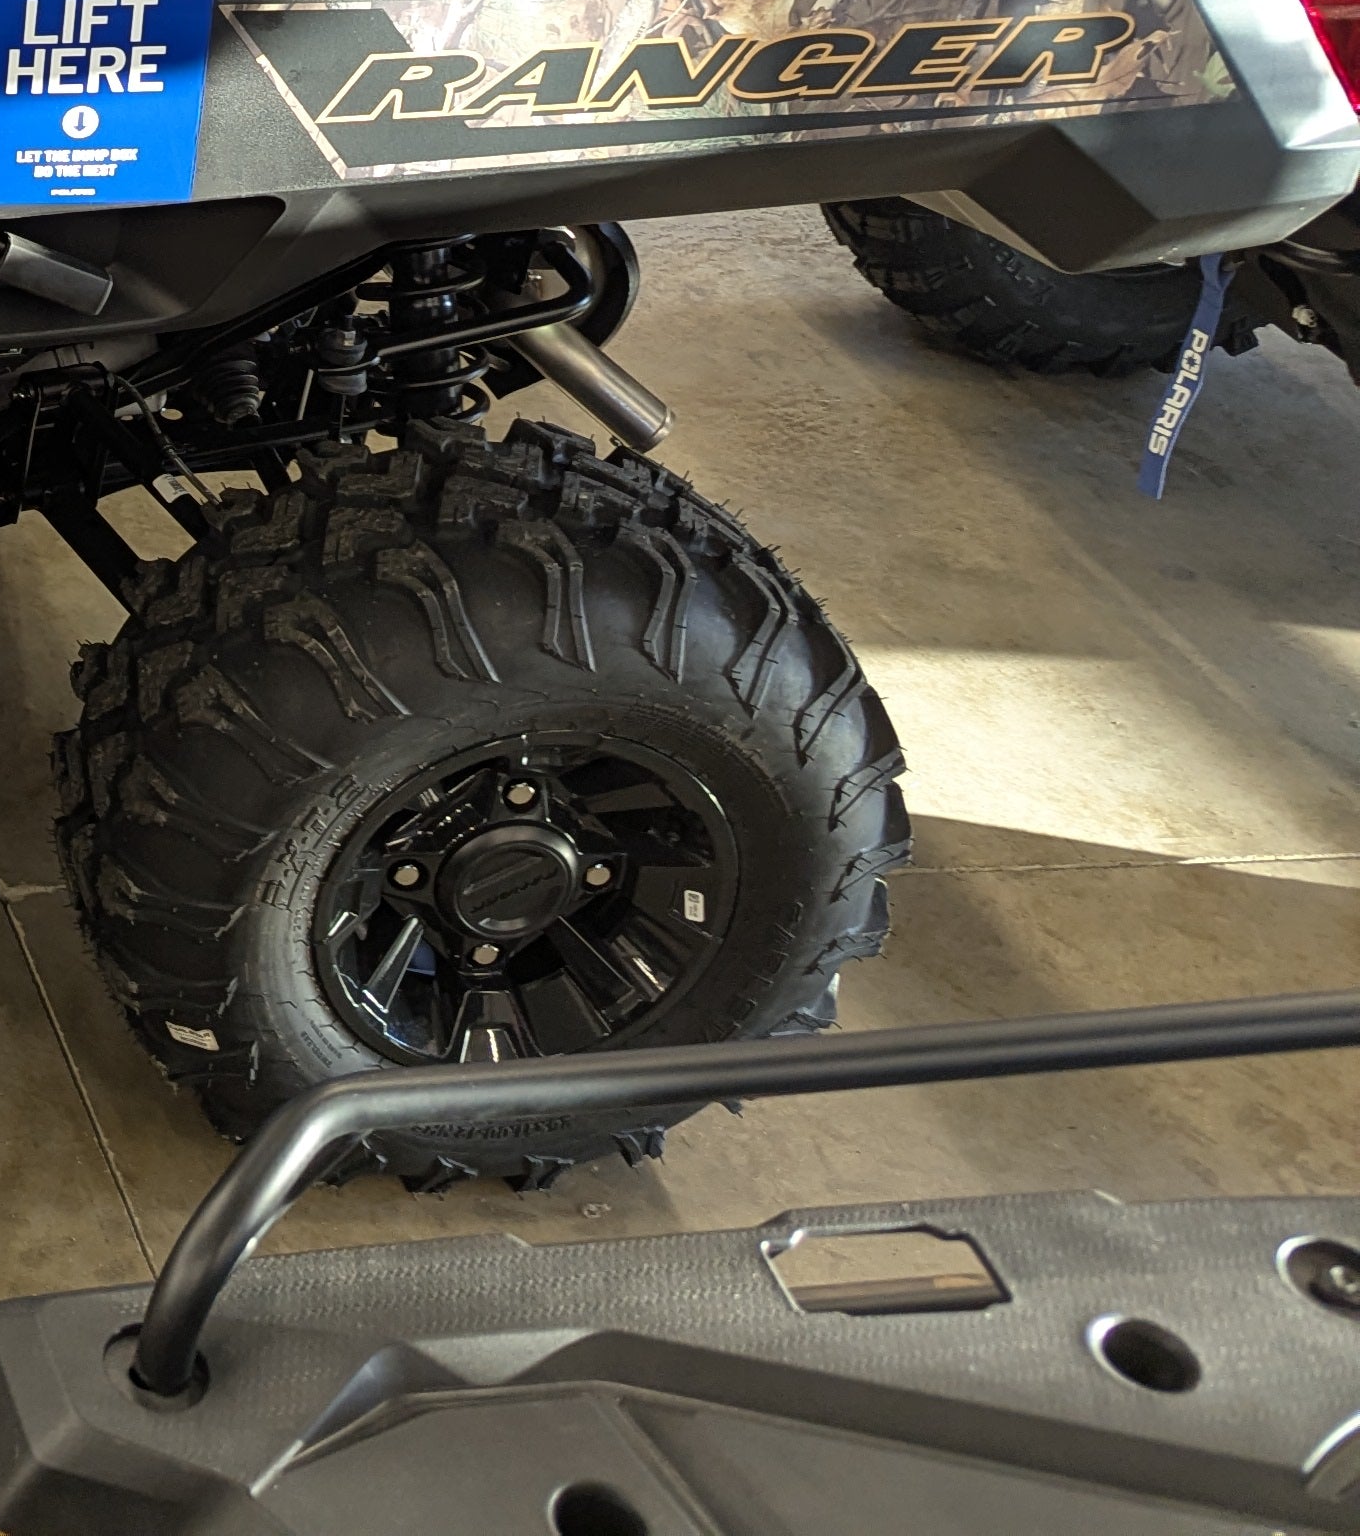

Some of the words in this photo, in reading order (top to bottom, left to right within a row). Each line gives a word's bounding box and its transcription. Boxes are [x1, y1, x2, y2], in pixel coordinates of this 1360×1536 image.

[5, 45, 167, 96] HERE
[316, 9, 1136, 125] RANGER
[16, 150, 44, 164] LET
[44, 150, 71, 163] THE
[55, 165, 82, 178] THE
[1148, 328, 1211, 457] POLARIS
